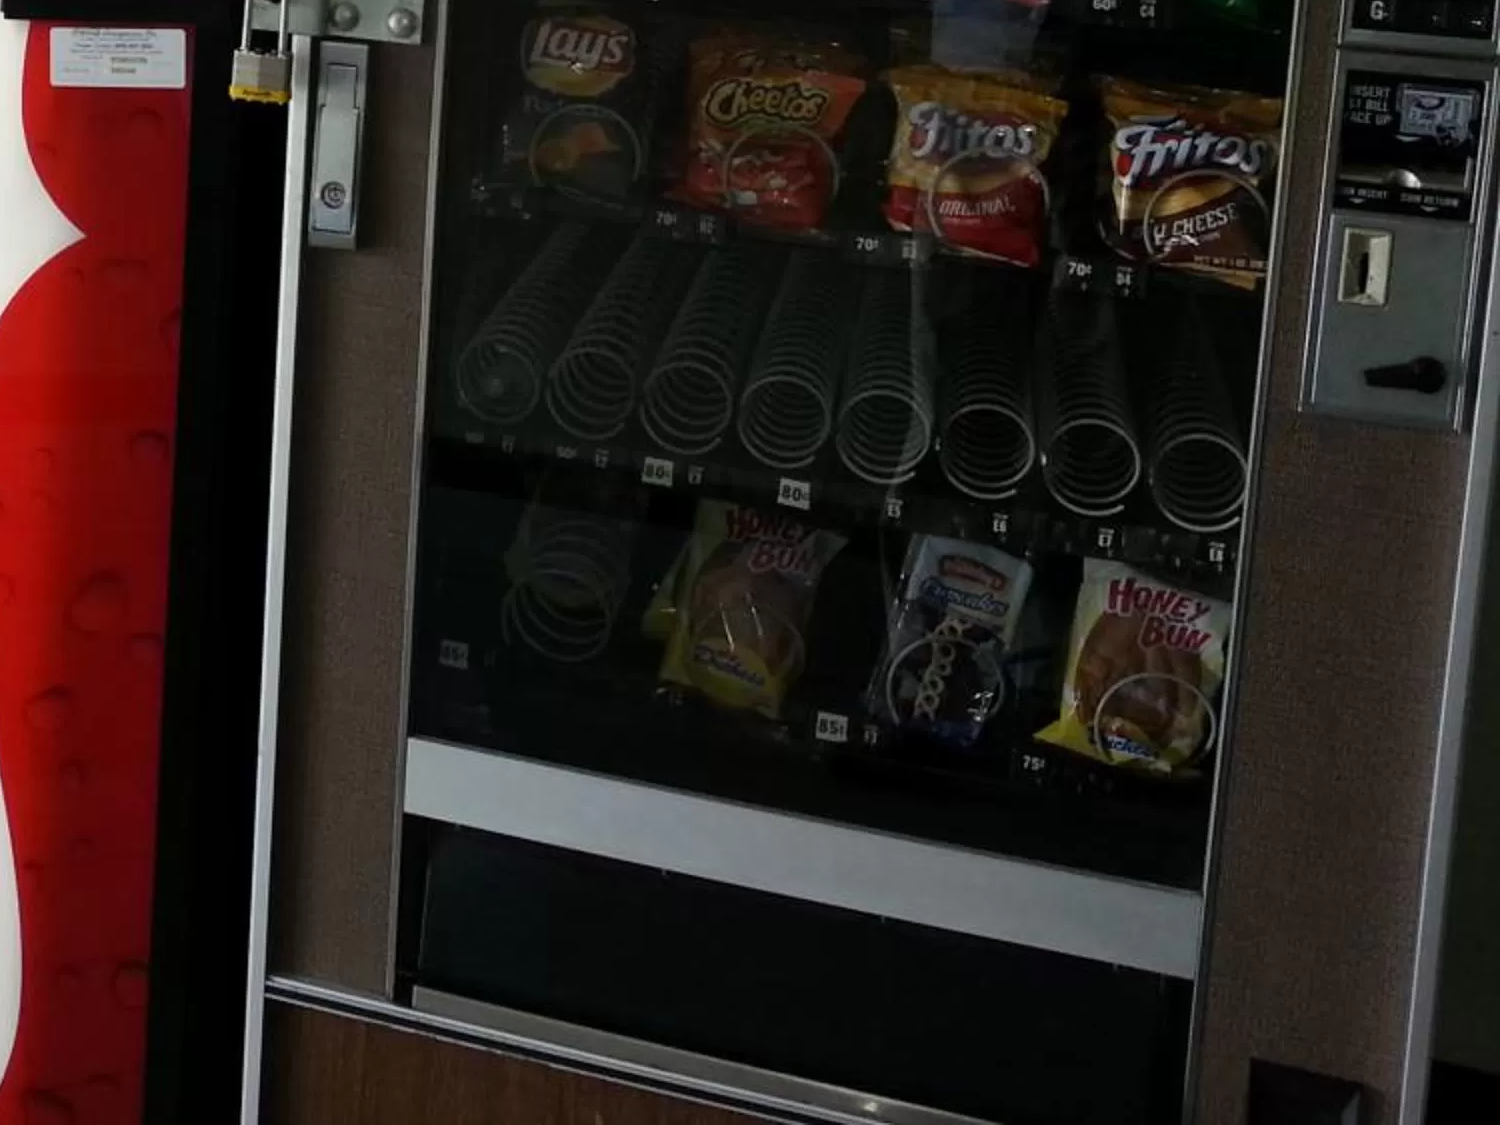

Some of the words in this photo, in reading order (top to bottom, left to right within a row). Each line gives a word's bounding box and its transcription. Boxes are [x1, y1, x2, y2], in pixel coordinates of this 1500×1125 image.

[1370, 0, 1385, 20] G
[530, 17, 629, 69] Lay's
[707, 80, 828, 126] Cheetos
[907, 101, 1038, 158] Fritos
[1116, 121, 1268, 187] Fritos
[1171, 203, 1238, 236] CHEESE
[1108, 577, 1211, 622] HONEY
[1140, 616, 1212, 651] BUN
